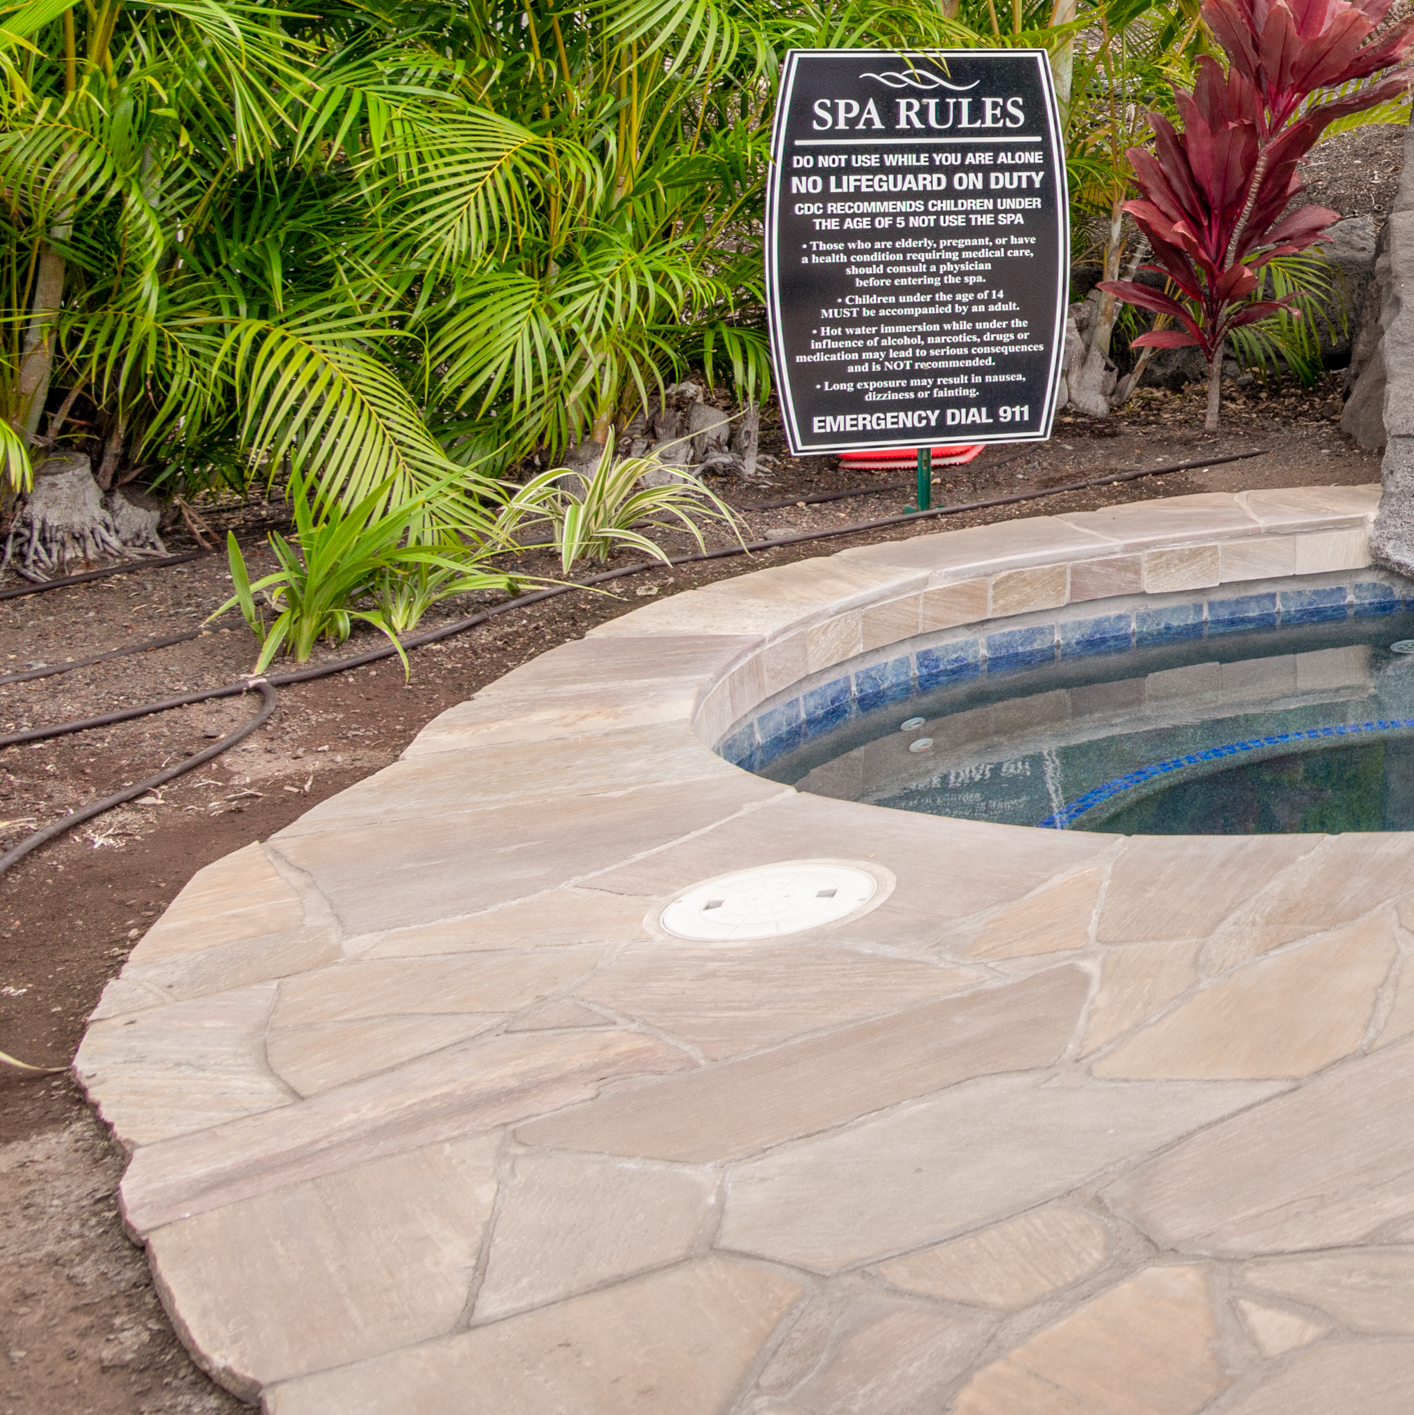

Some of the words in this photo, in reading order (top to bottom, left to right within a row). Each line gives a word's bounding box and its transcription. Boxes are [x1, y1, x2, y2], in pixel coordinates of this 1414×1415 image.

[812, 97, 885, 131] SPA
[895, 96, 1025, 129] RULES
[792, 155, 814, 168] DO
[818, 154, 849, 168] NOT
[851, 154, 881, 167] USE
[883, 153, 930, 167] WHILE
[932, 152, 962, 166] YOU
[964, 152, 994, 165] ARE
[996, 151, 1044, 164] ALONE
[791, 175, 823, 194] NO
[829, 173, 947, 193] LIFEGUARD
[953, 172, 983, 191] ON
[990, 171, 1045, 190] DUTY
[794, 202, 824, 215] CDC
[827, 200, 925, 214] RECOMMENDS
[927, 198, 994, 212] CHILDREN
[996, 197, 1042, 210] UNDER
[812, 218, 840, 231] THE
[843, 217, 872, 230] AGE
[874, 216, 894, 229] OF
[896, 216, 906, 228] 5
[908, 215, 937, 228] NOT
[939, 214, 967, 227] USE
[968, 213, 995, 226] THE
[997, 213, 1025, 225] SPA
[809, 240, 845, 251] Those
[847, 239, 872, 250] who
[874, 241, 893, 249] are
[895, 237, 937, 250] elderly,
[939, 236, 993, 249] pregnant,
[994, 237, 1008, 245] or
[1010, 234, 1037, 245] have
[801, 256, 809, 264] a
[811, 252, 848, 264] health
[850, 251, 904, 263] condition
[906, 249, 960, 263] requiring
[961, 247, 1005, 259] medical
[1006, 249, 1034, 258] care,
[845, 264, 884, 275] should
[886, 262, 927, 274] consult
[929, 264, 937, 272] a
[939, 260, 992, 274] physician
[855, 276, 892, 288] before
[893, 274, 942, 287] entering
[943, 274, 962, 284] the
[963, 275, 987, 286] spa.
[844, 294, 896, 305] Children
[898, 292, 933, 303] under
[934, 291, 953, 302] the
[955, 292, 975, 303] age
[976, 289, 990, 300] of
[991, 289, 1005, 300] 14
[820, 307, 860, 319] MUST
[862, 307, 877, 317] be
[878, 303, 952, 318] accompanied
[954, 303, 969, 315] by
[971, 304, 986, 313] an
[987, 301, 1020, 312] adult.
[820, 326, 843, 337] Hot
[844, 325, 879, 335] water
[880, 322, 940, 334] immersion
[942, 320, 973, 331] while
[975, 319, 1009, 330] under
[1010, 318, 1029, 328] the
[810, 338, 865, 350] influence
[866, 336, 880, 347] of
[880, 334, 925, 346] alcohol,
[927, 332, 981, 344] narcotics,
[982, 331, 1015, 343] drugs
[1016, 332, 1030, 340] or
[795, 350, 859, 363] medication
[861, 351, 887, 361] may
[889, 347, 913, 359] lead
[915, 348, 927, 357] to
[929, 345, 969, 357] serious
[971, 343, 1045, 355] consequences
[847, 362, 869, 373] and
[871, 361, 882, 372] is
[883, 360, 913, 371] NOT
[914, 356, 996, 370] recommended.
[824, 381, 855, 392] Long
[856, 379, 908, 391] exposure
[910, 378, 935, 388] may
[937, 374, 969, 385] result
[971, 373, 982, 384] in
[985, 373, 1026, 383] nausea,
[864, 390, 915, 402] dizziness
[917, 390, 931, 399] or
[932, 386, 980, 398] fainting.
[812, 409, 941, 433] EMERGENCY
[946, 407, 994, 426] DIAL
[998, 404, 1029, 423] 911
